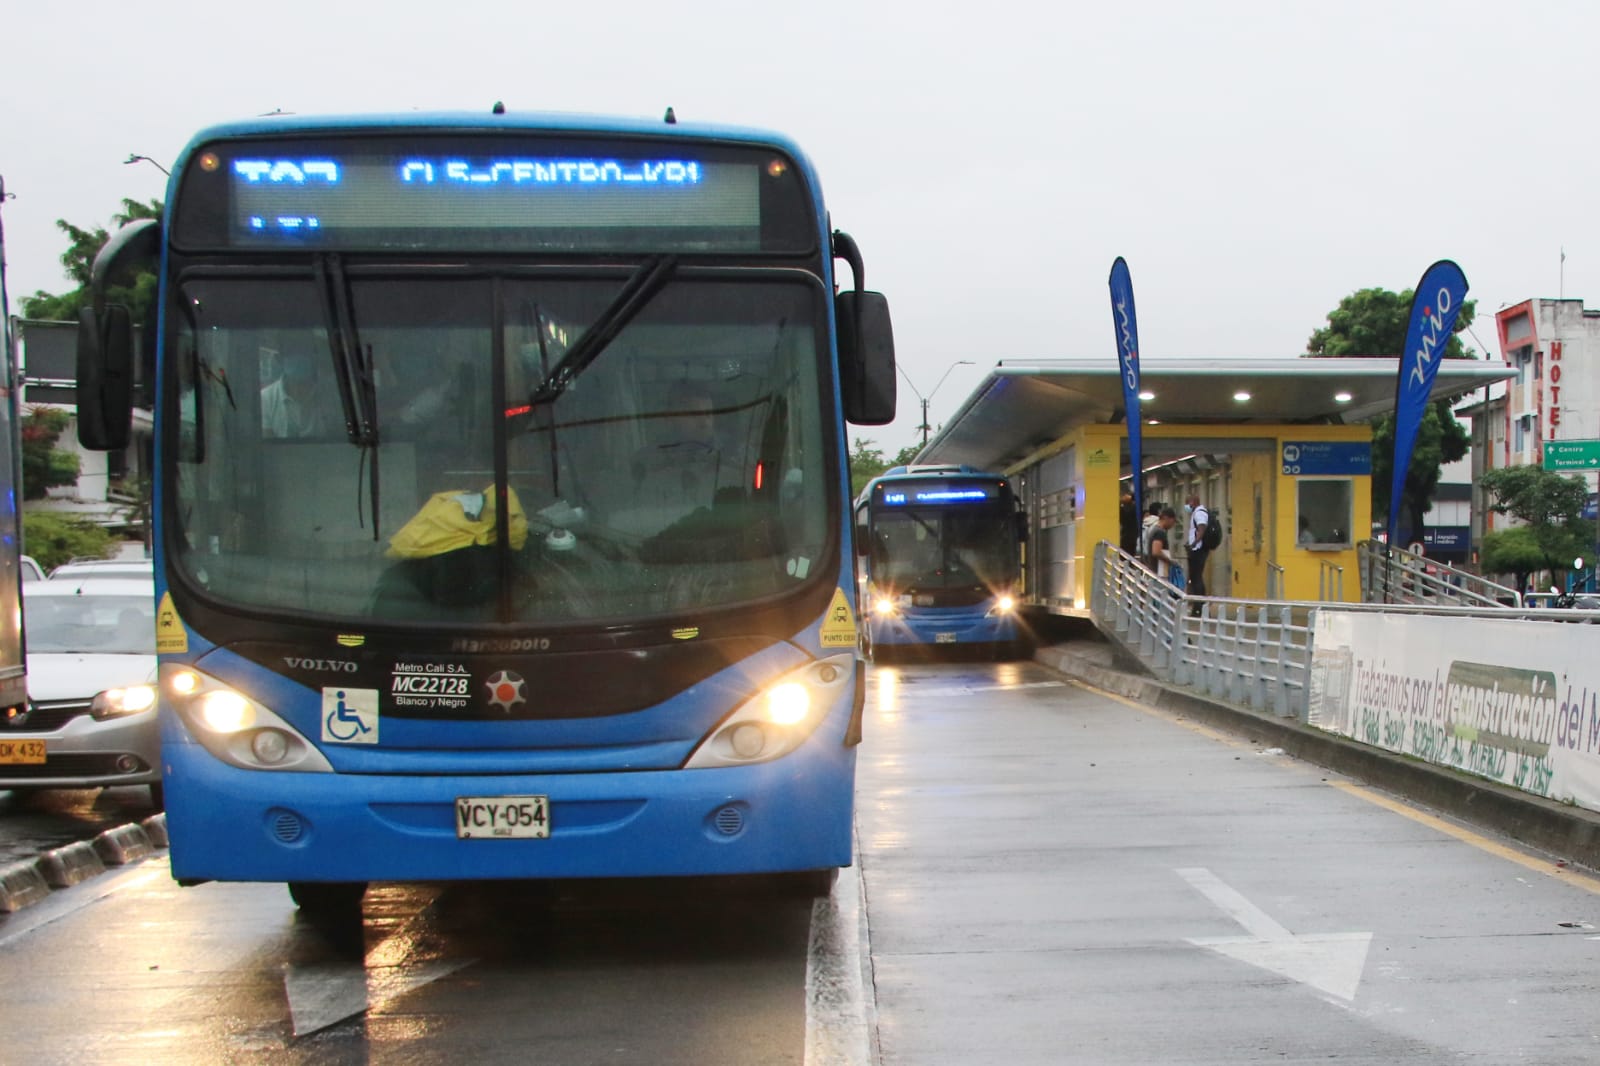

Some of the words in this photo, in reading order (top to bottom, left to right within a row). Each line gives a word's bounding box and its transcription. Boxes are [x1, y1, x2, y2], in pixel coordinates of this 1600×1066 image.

[1558, 446, 1584, 454] Centro
[284, 656, 359, 673] VOLVO
[395, 663, 424, 673] Metro
[425, 663, 445, 673] Cali
[447, 664, 467, 674] S.A.
[392, 676, 468, 694] MC22128
[396, 696, 428, 707] Blanco
[438, 698, 467, 709] Negro
[1355, 659, 1409, 713] Trabajamos
[1411, 677, 1432, 727] por
[1433, 668, 1445, 721] la
[1446, 674, 1555, 745] reconstrucción
[1557, 685, 1587, 750] del
